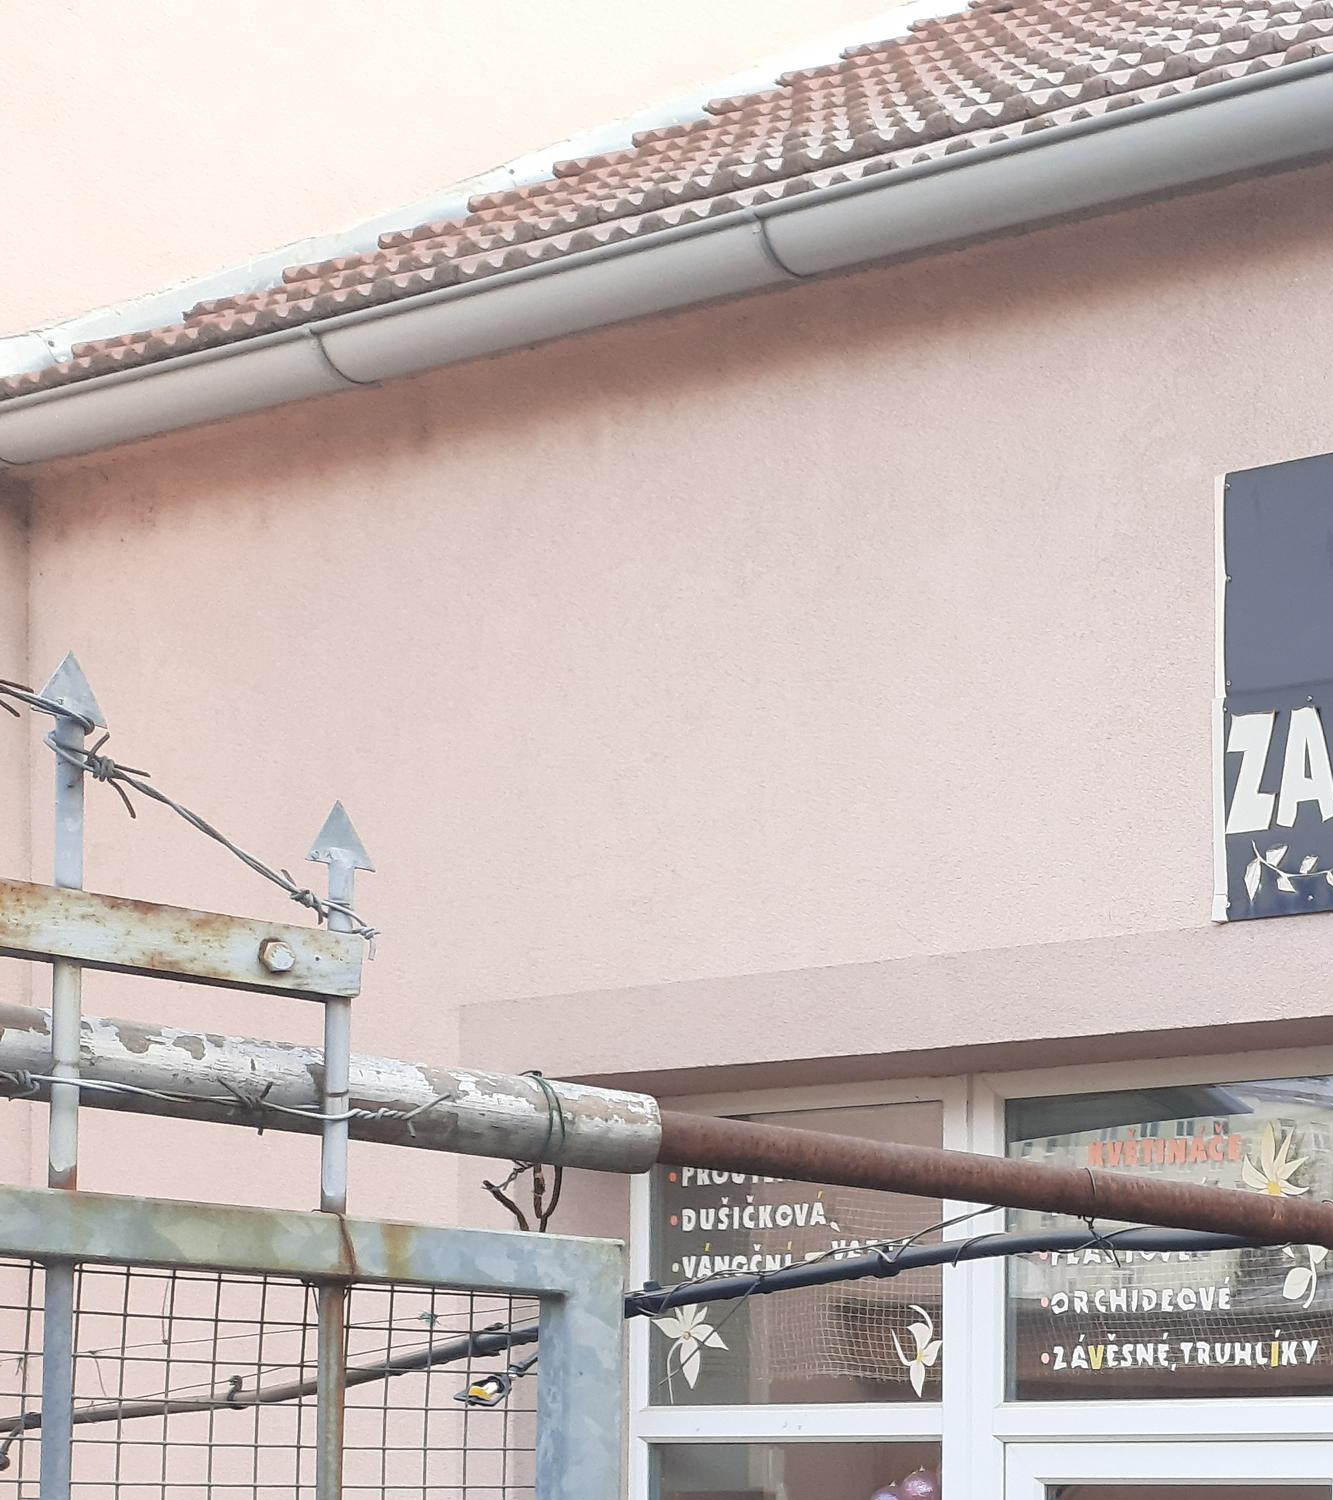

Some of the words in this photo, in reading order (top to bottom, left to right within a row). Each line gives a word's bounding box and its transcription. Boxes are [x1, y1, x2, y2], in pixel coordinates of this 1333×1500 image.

[1088, 1122, 1242, 1168] KVĚTINÁČE
[1051, 1277, 1231, 1314] ORCHIDEOVÉ
[1180, 1329, 1319, 1367] TRUHLÍKY
